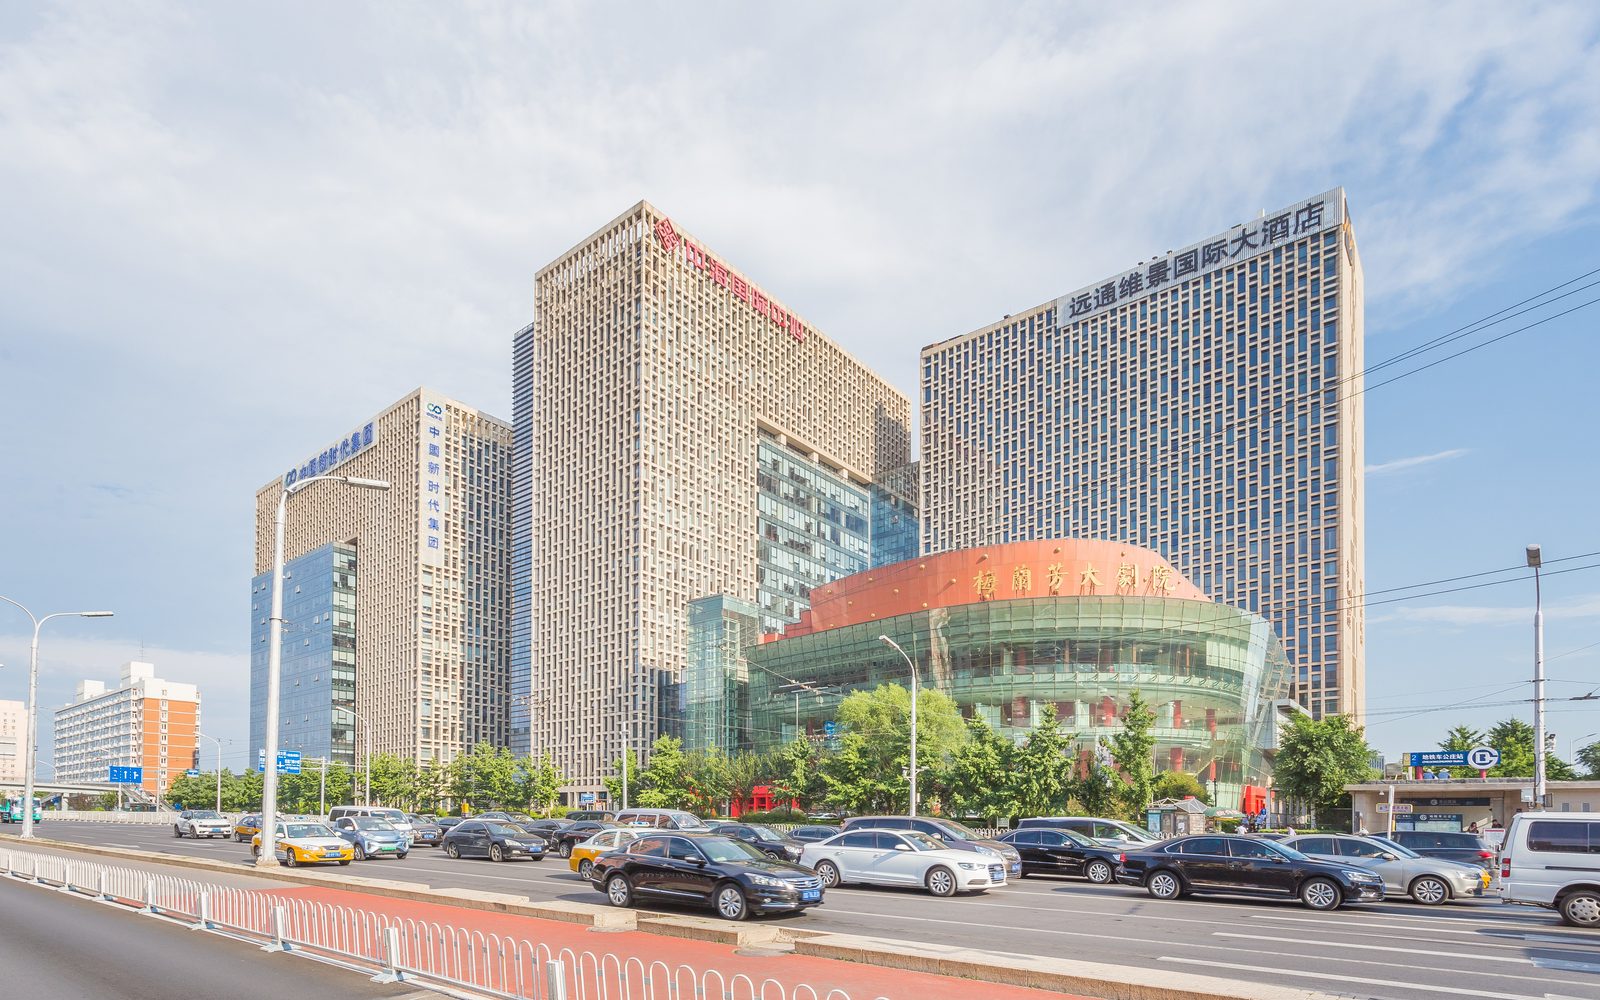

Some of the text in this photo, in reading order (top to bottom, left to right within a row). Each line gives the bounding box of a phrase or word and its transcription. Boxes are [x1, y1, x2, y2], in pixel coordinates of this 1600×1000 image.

[686, 239, 805, 344] 中海国际中心
[1068, 200, 1324, 319] 远通维景国际大酒店
